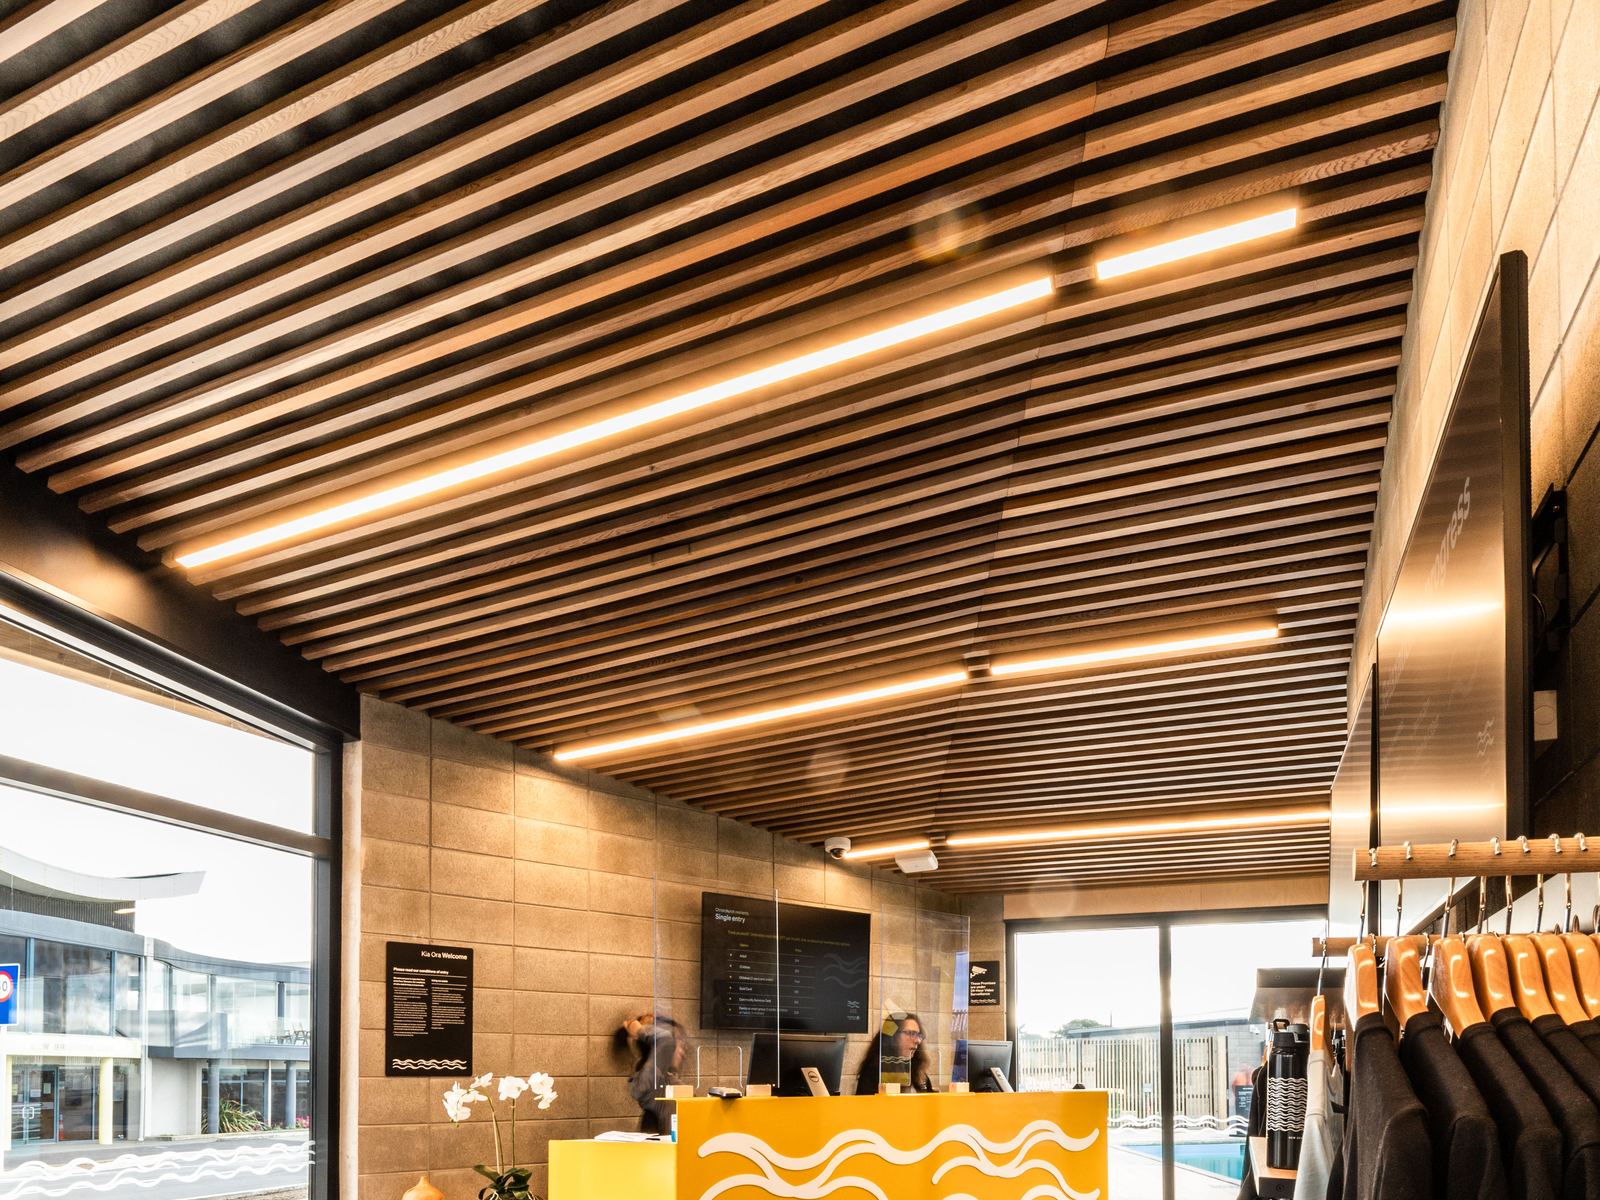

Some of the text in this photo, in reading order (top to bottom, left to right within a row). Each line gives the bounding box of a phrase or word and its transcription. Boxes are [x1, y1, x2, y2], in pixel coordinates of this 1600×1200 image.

[715, 913, 746, 924] Single entry
[442, 952, 467, 960] Welcome
